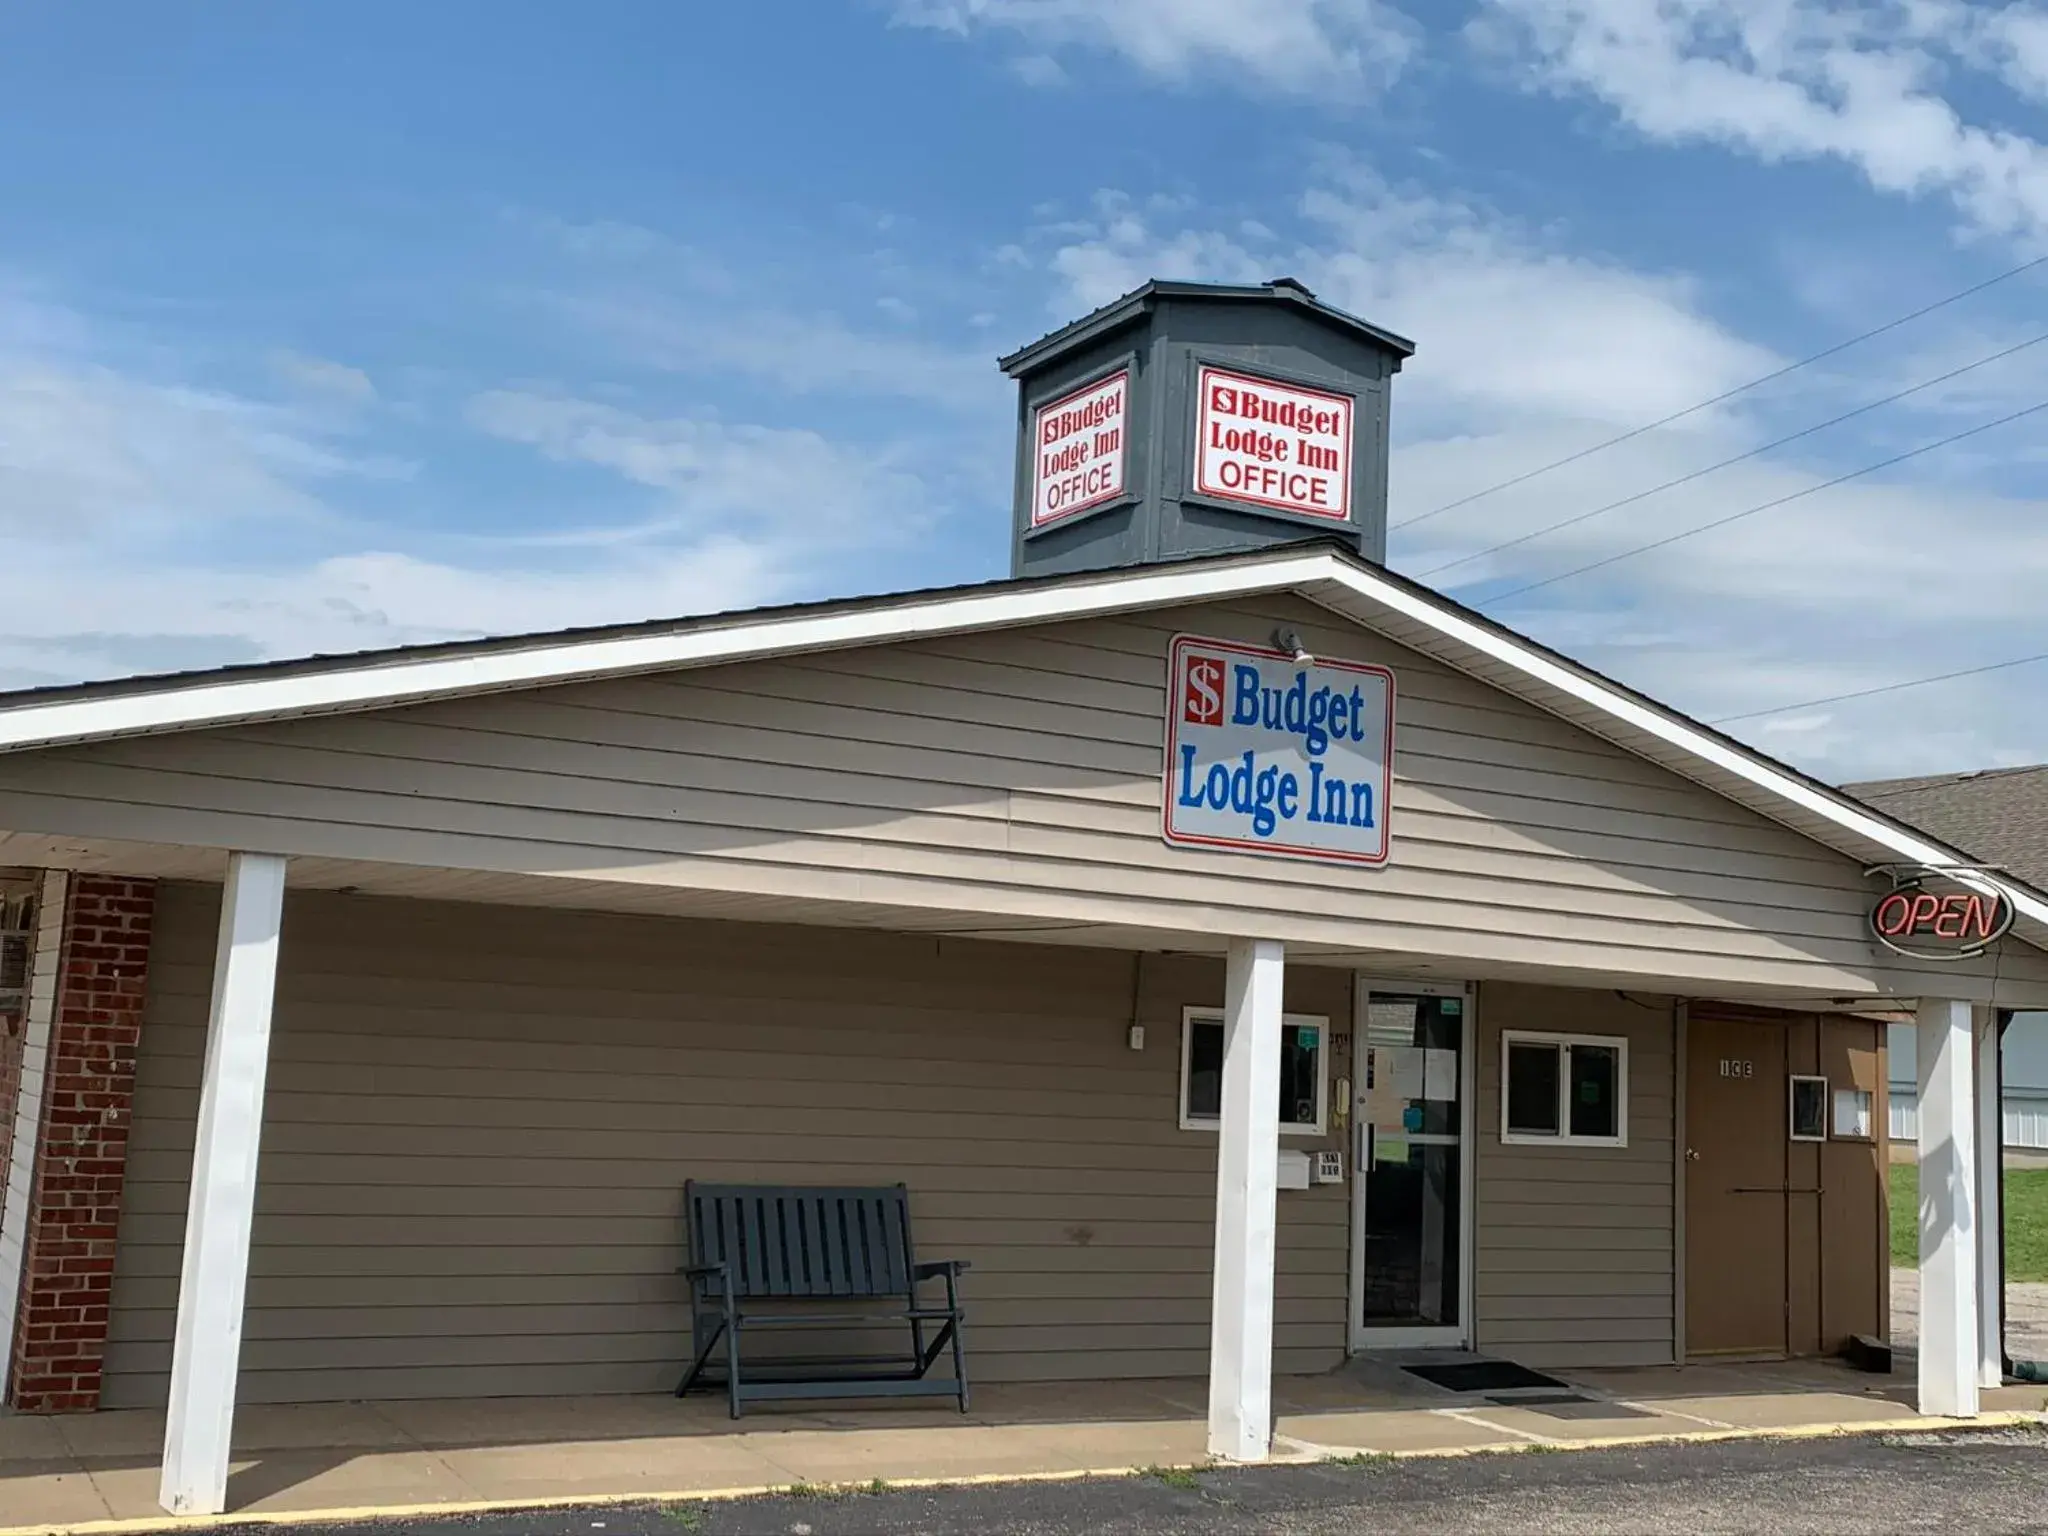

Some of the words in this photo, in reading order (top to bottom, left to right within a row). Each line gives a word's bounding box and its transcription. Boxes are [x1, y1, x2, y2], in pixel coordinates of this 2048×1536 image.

[1061, 388, 1121, 439] Budget
[1241, 391, 1340, 436] Budget
[1043, 441, 1088, 479] Lodge
[1094, 428, 1119, 458] Inn
[1211, 421, 1288, 462] Lodge
[1297, 439, 1338, 471] Inn
[1048, 463, 1112, 509] OFFICE
[1220, 461, 1328, 504] OFFICE
[1232, 664, 1365, 756] Budget
[1179, 744, 1298, 837] Lodge
[1307, 762, 1374, 828] Inn
[1877, 895, 1999, 937] OPEN
